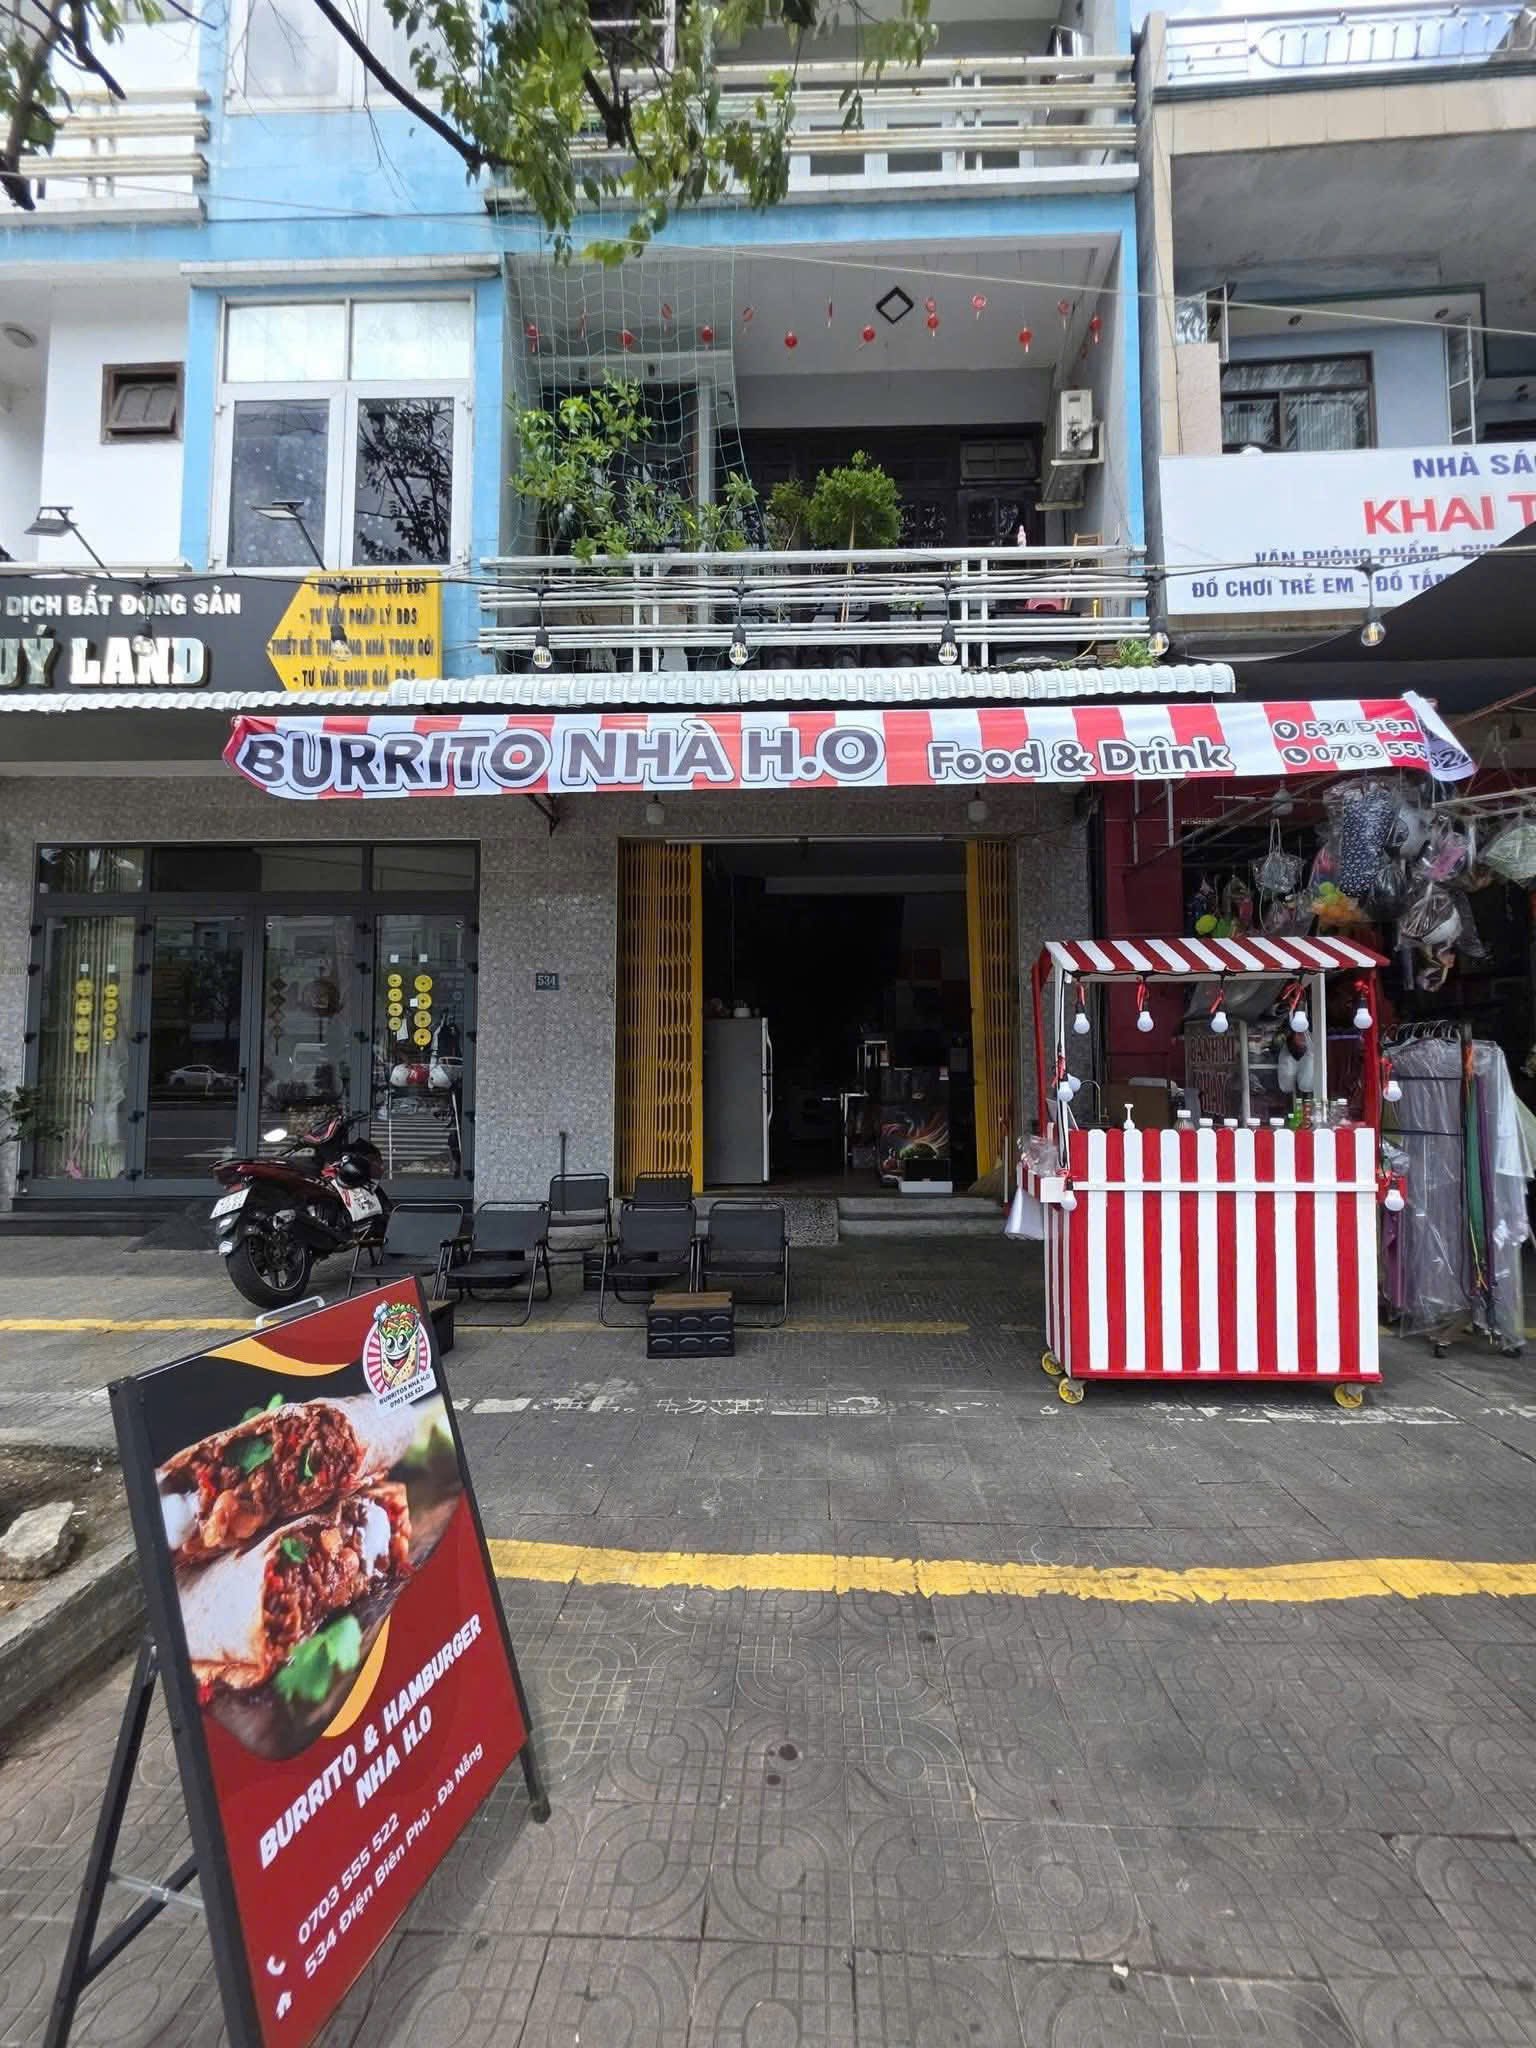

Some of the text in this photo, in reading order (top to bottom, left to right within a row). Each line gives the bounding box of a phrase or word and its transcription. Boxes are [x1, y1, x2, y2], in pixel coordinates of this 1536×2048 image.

[1413, 449, 1536, 478] NHÀ SÁ
[1362, 495, 1495, 535] KHAI
[6, 595, 62, 624] DỊCH
[193, 584, 241, 615] SẢN
[1279, 572, 1315, 596] TRẺ
[1322, 577, 1354, 594] EM
[69, 637, 205, 685] LAND
[1303, 721, 1351, 738] 534
[237, 721, 882, 791] BURRITO NHÀ H.O
[930, 737, 1231, 777] Food & Drink
[1314, 744, 1381, 761] 0703
[259, 1613, 482, 1870] BURRITO & HAMBURGER
[402, 1705, 432, 1756] H.O
[298, 1812, 399, 1945] 0703 555 522
[304, 1927, 337, 1979] 534
[339, 1883, 374, 1934] Điện
[374, 1843, 406, 1888] Biên
[405, 1807, 431, 1848] Phủ
